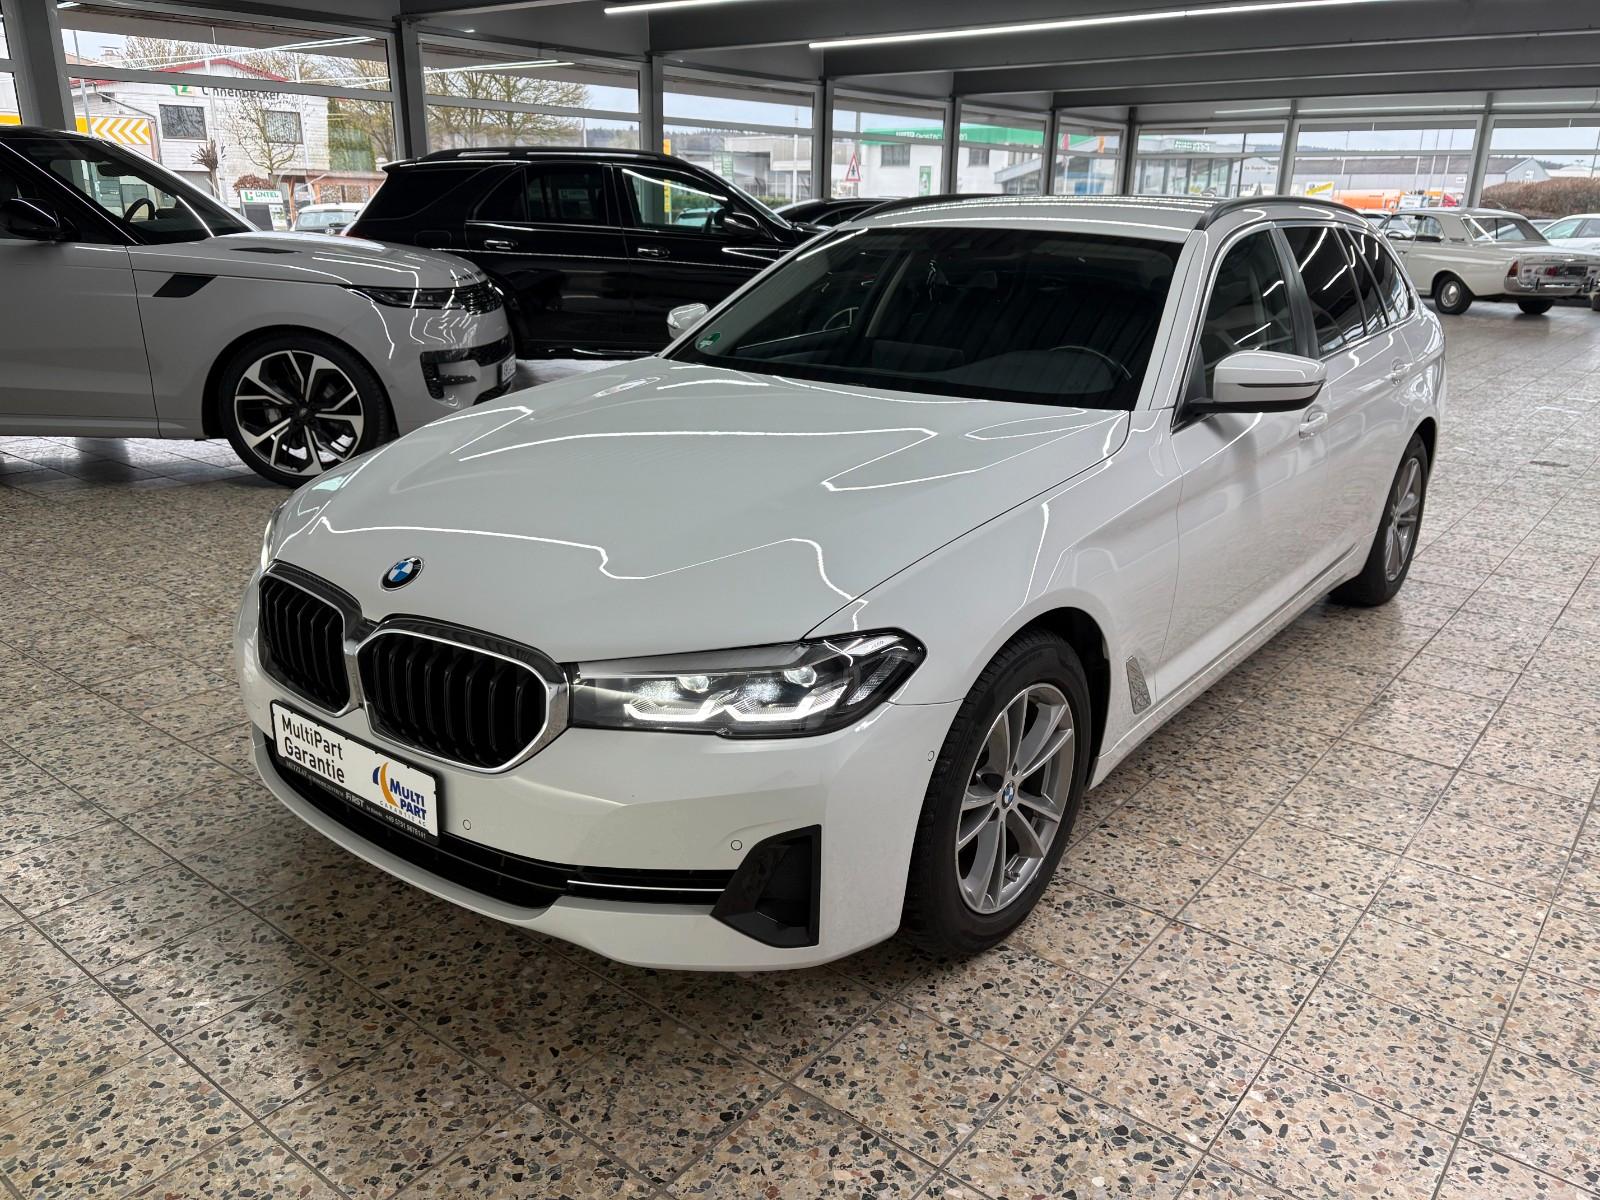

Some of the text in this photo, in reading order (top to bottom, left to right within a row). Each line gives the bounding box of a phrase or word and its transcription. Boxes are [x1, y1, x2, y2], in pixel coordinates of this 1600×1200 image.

[282, 714, 343, 761] MultiPart
[284, 737, 345, 784] Garantie
[390, 778, 425, 806] MULTI
[400, 799, 427, 821] PART
